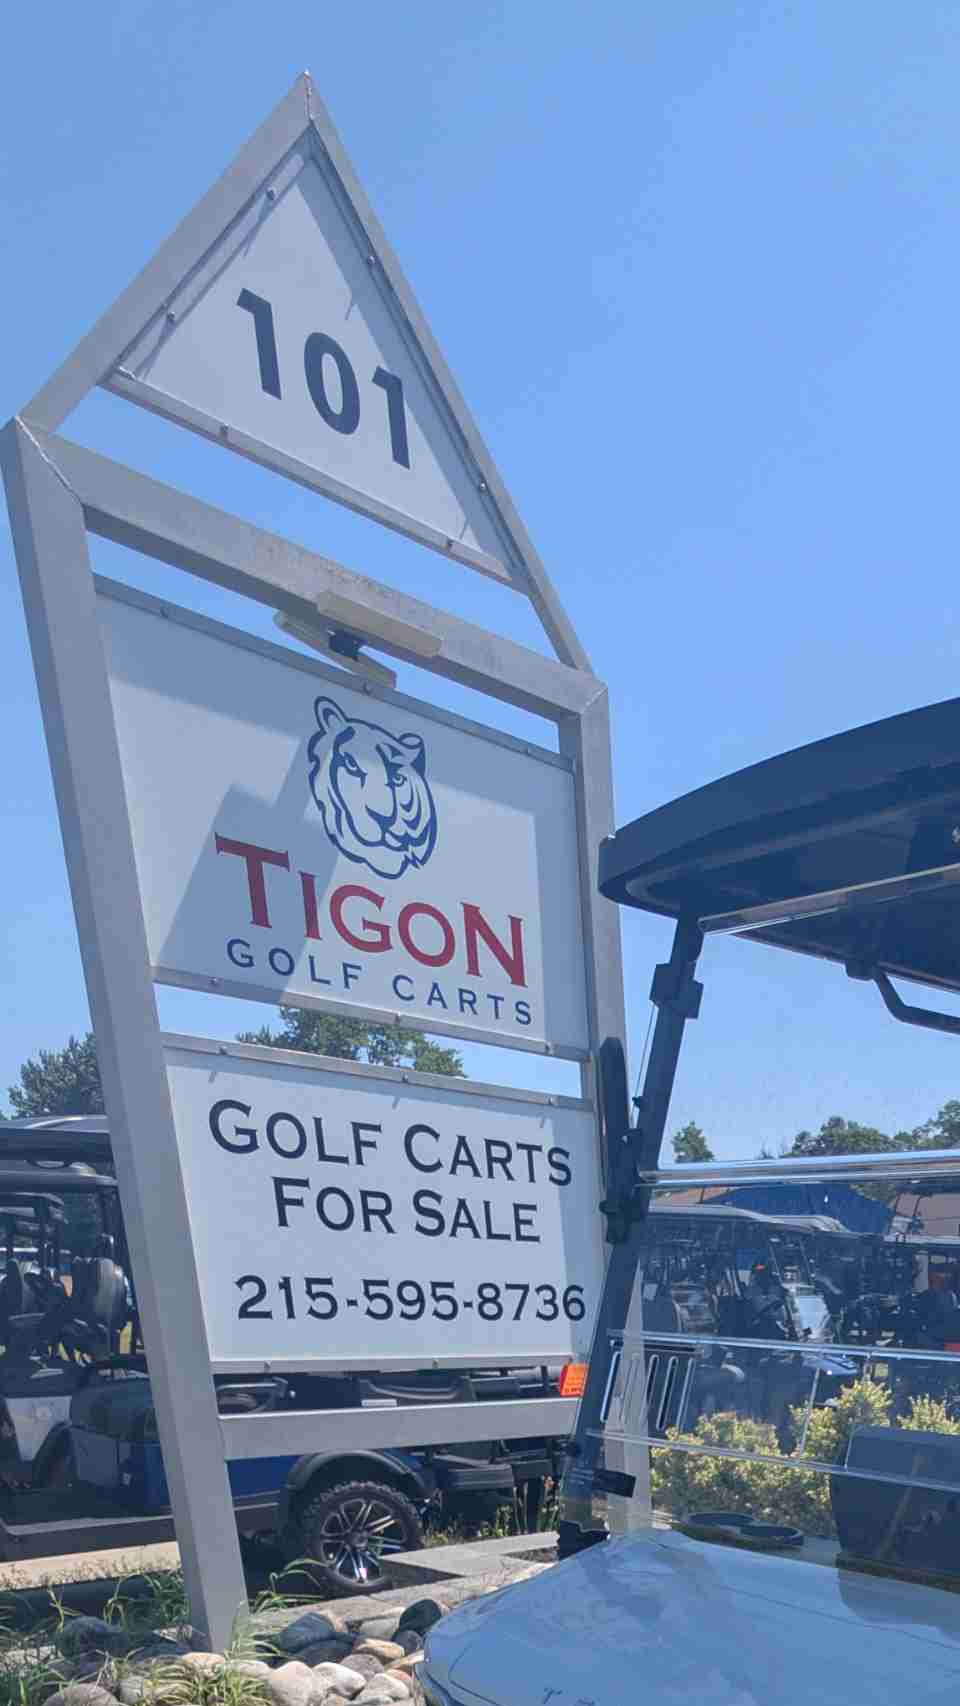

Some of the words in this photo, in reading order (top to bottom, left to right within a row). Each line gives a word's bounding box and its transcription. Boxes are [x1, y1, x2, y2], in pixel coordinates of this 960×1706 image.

[236, 287, 410, 470] 101
[214, 832, 528, 987] TIGON
[226, 938, 362, 989] GOLF
[392, 974, 532, 1026] CARTS
[208, 1098, 382, 1166] GOLF
[403, 1123, 572, 1187] CARTS
[271, 1175, 397, 1234] FOR
[412, 1188, 541, 1243] SALE
[233, 1274, 587, 1322] 215-595-8736
